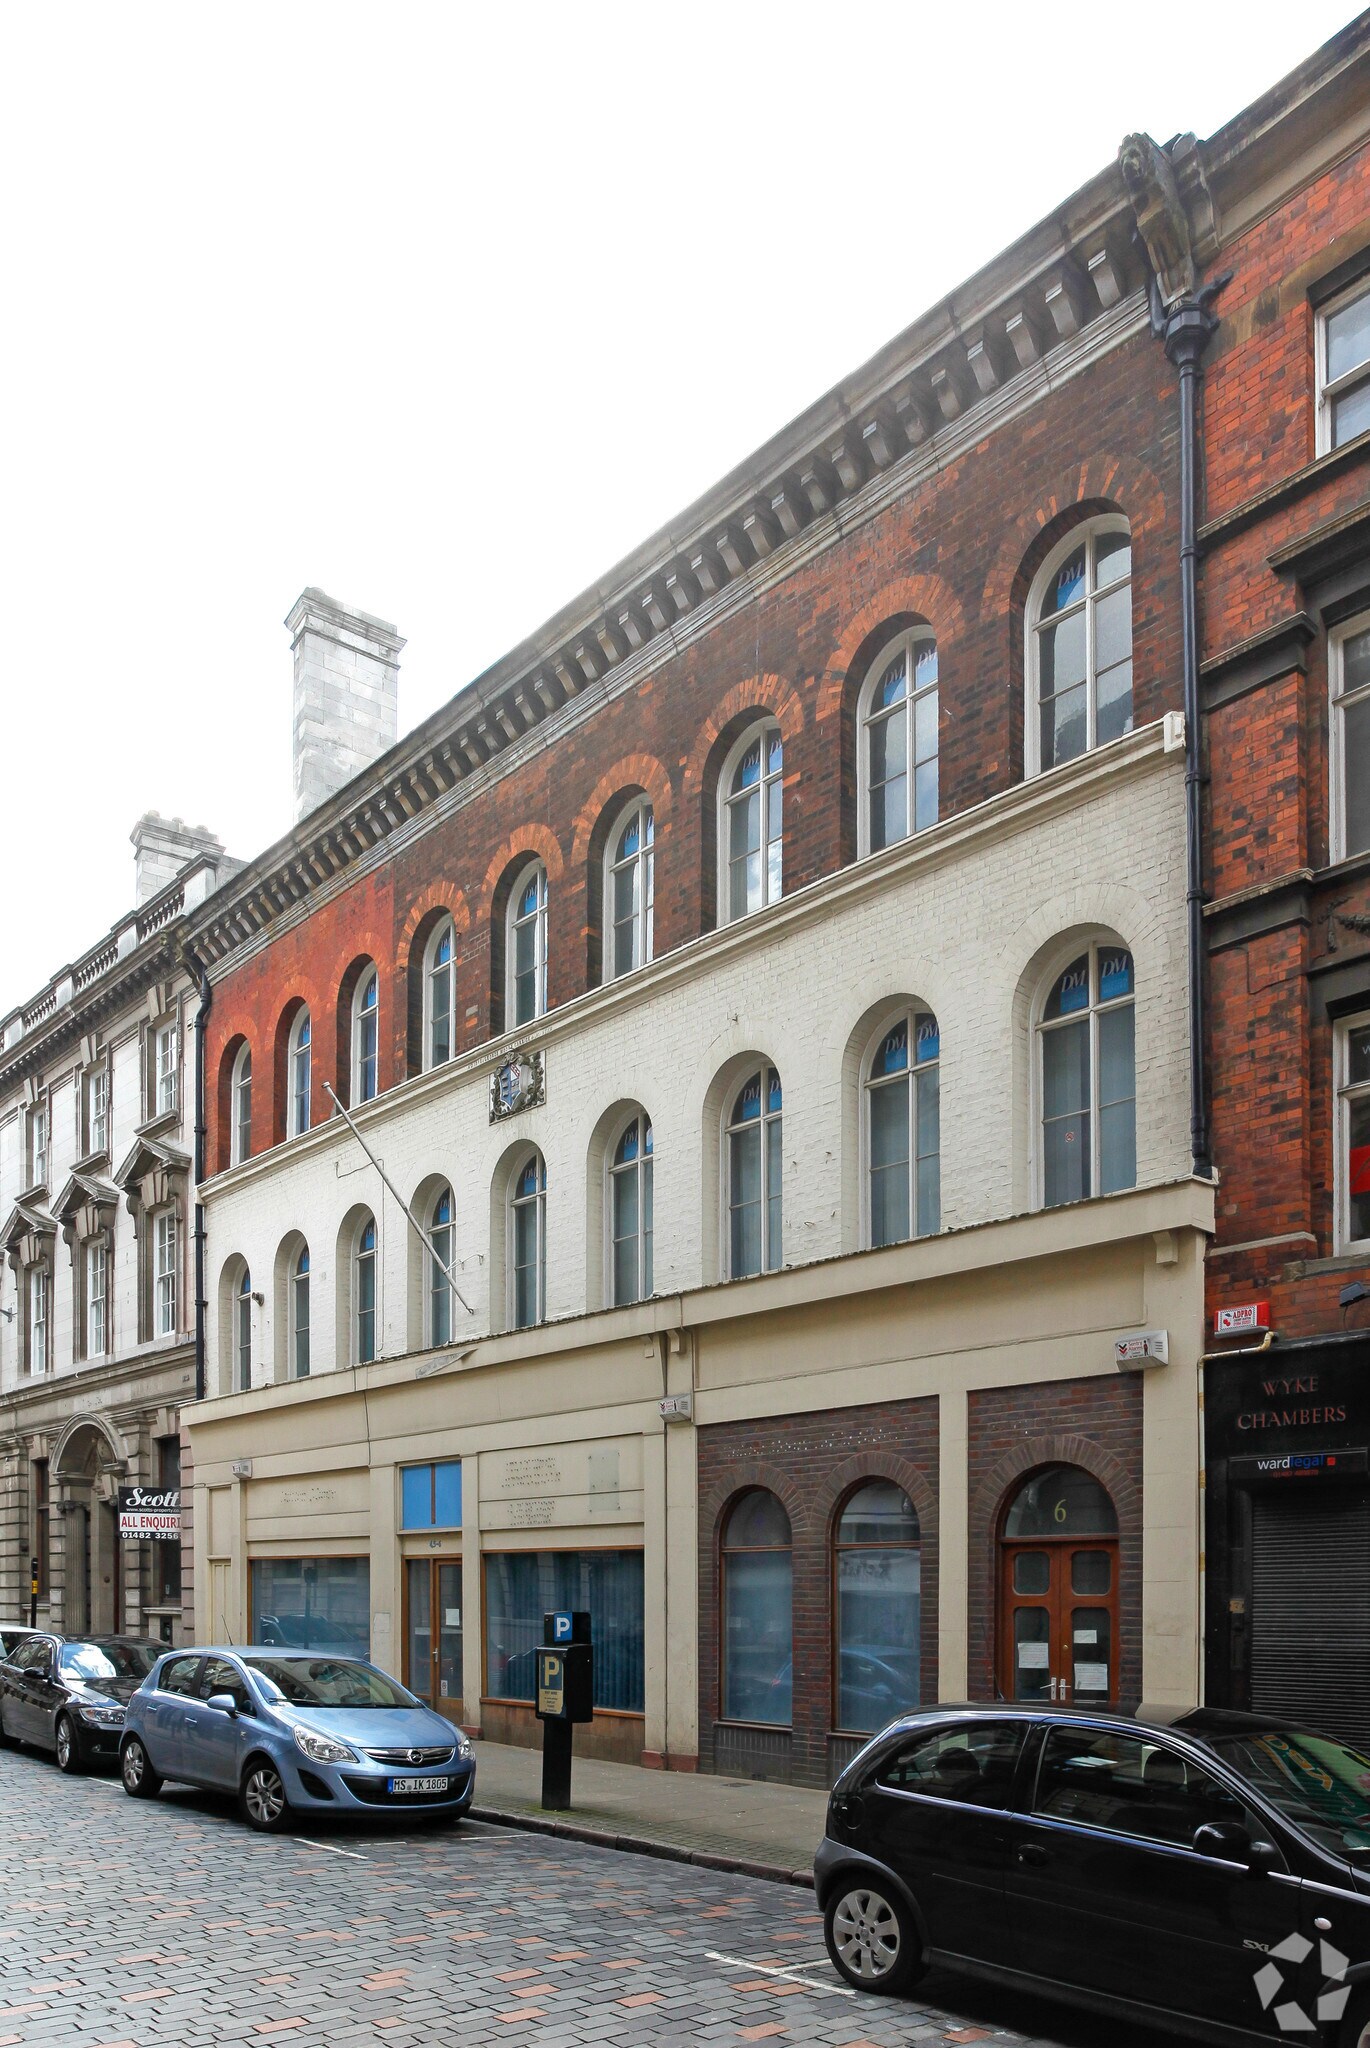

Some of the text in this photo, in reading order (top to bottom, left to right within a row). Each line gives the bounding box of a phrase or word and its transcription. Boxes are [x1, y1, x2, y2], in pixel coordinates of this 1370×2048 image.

[1232, 1309, 1253, 1319] ADPRO
[1263, 1377, 1319, 1396] WYKE
[1237, 1405, 1346, 1430] CHAMBERS
[126, 1487, 181, 1507] Scott
[1054, 1498, 1067, 1523] 6
[121, 1516, 138, 1528] ALL
[122, 1531, 181, 1540] 01482 3256
[556, 1617, 571, 1638] P
[544, 1656, 560, 1687] P
[394, 1778, 447, 1791] MS IK 1805
